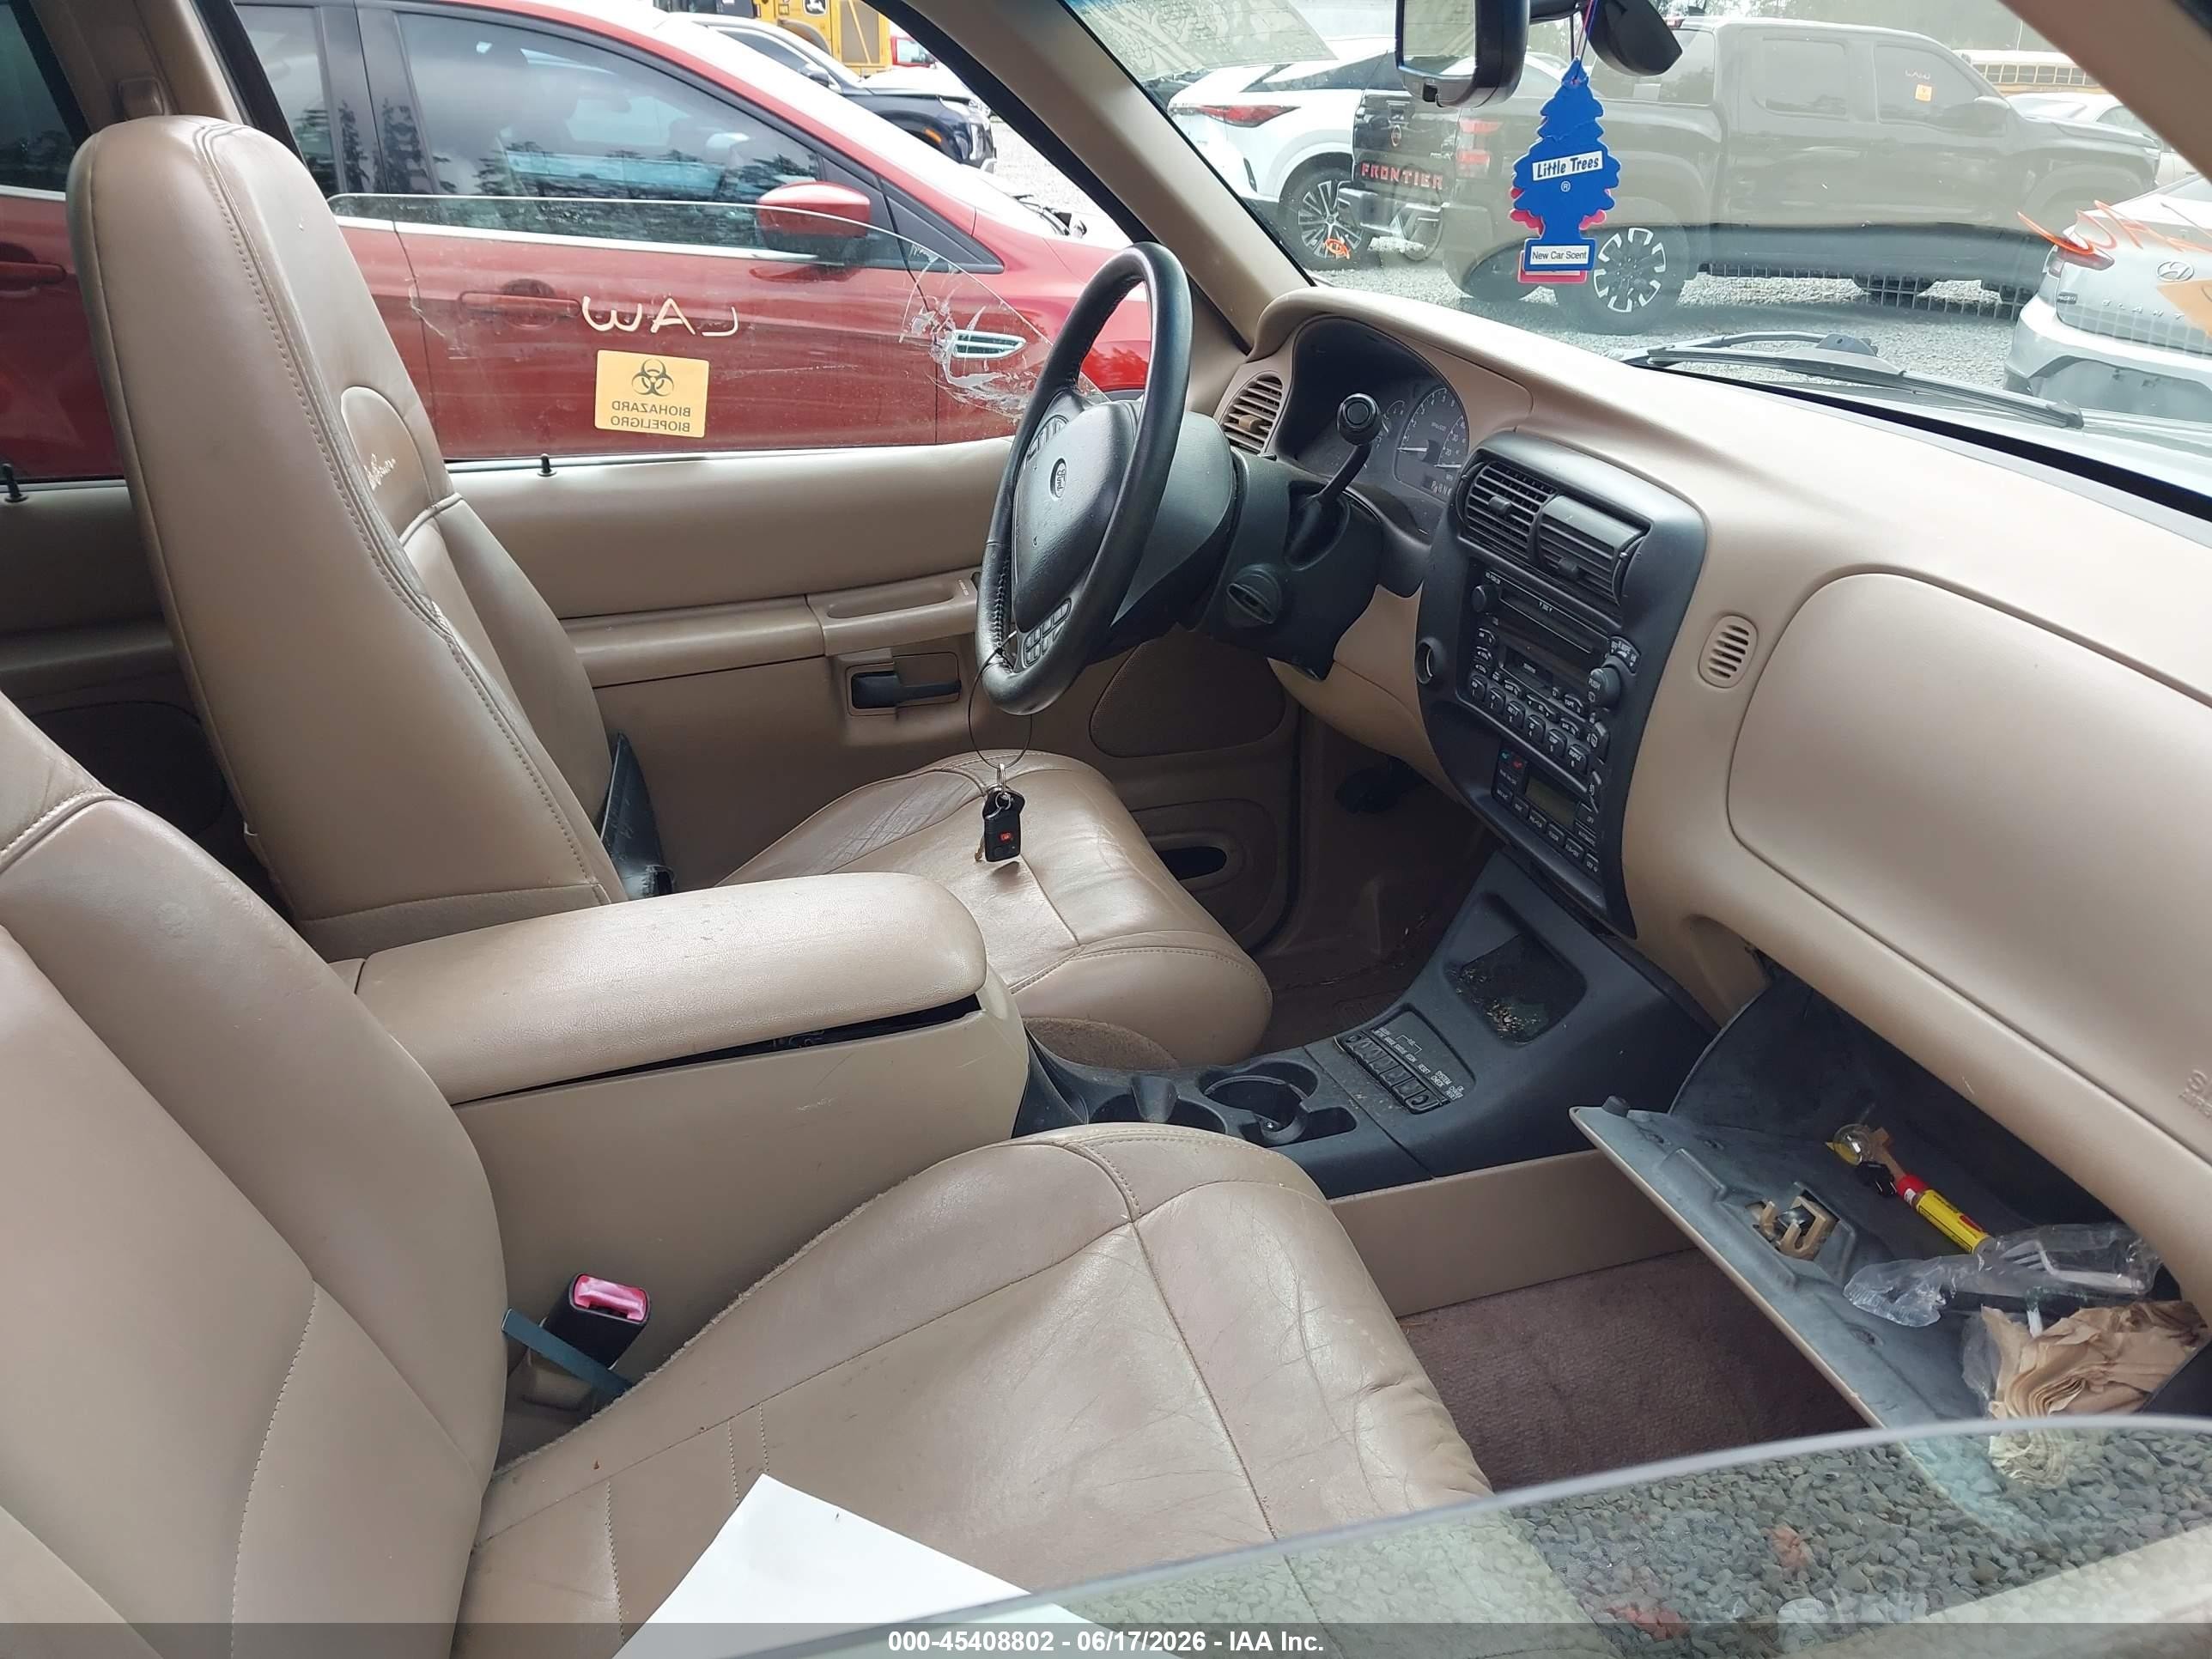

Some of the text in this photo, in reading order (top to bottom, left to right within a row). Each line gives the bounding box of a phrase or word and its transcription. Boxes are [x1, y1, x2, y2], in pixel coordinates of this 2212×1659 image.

[1537, 156, 1600, 179] Little Trees
[1361, 162, 1443, 190] FRONTIER
[1532, 250, 1587, 260] New Car Scent
[1589, 678, 1601, 690] PUSH
[1436, 1070, 1452, 1085] SYSTEM
